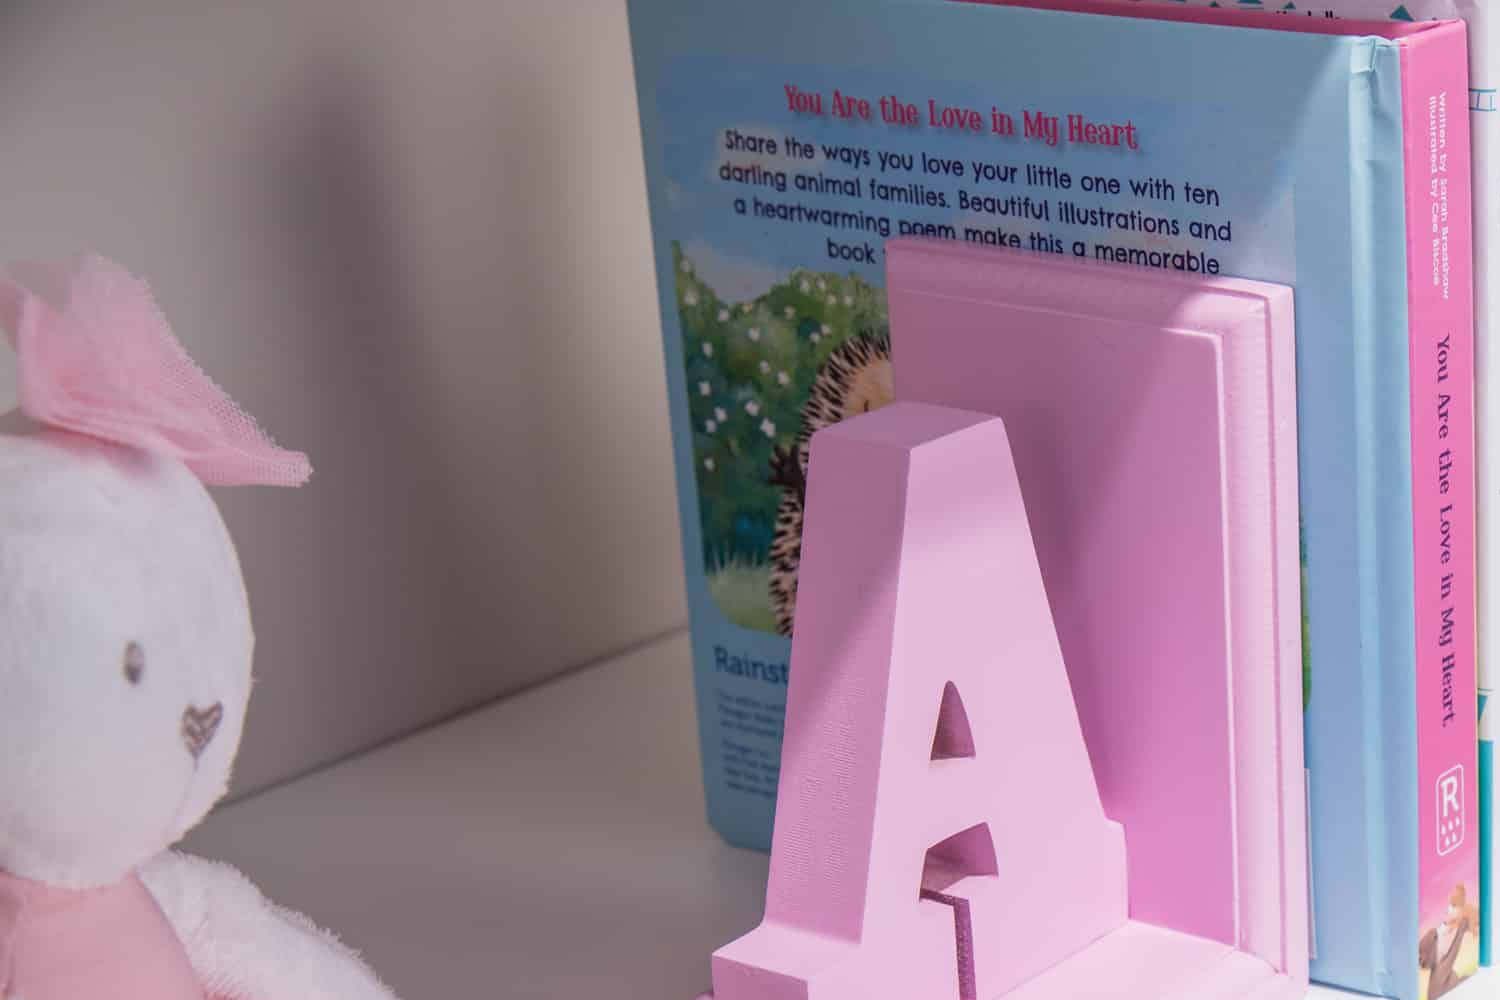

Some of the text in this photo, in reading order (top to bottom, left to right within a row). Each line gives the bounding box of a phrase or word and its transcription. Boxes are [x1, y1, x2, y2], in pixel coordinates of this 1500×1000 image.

[783, 83, 1139, 149] You Are the Love in My Heart
[1429, 95, 1438, 174] Illustrated
[1439, 91, 1448, 150] Written
[725, 129, 1220, 207] Share the ways you love your little one with ten
[1439, 153, 1448, 173] by
[719, 162, 1232, 243] darling animal families. Beautiful illustrations and
[733, 197, 747, 216] a
[753, 196, 891, 237] heartwarming
[964, 226, 1022, 249] make
[1030, 231, 1064, 255] this
[1072, 240, 1086, 257] a
[1095, 243, 1220, 275] memorable
[826, 237, 877, 265] book
[1436, 333, 1450, 384] You
[1437, 393, 1451, 440] Are
[1438, 448, 1453, 495] the
[1439, 504, 1453, 565] Love
[1440, 573, 1454, 600] in
[1439, 606, 1455, 647] My
[1440, 774, 1460, 818] R
